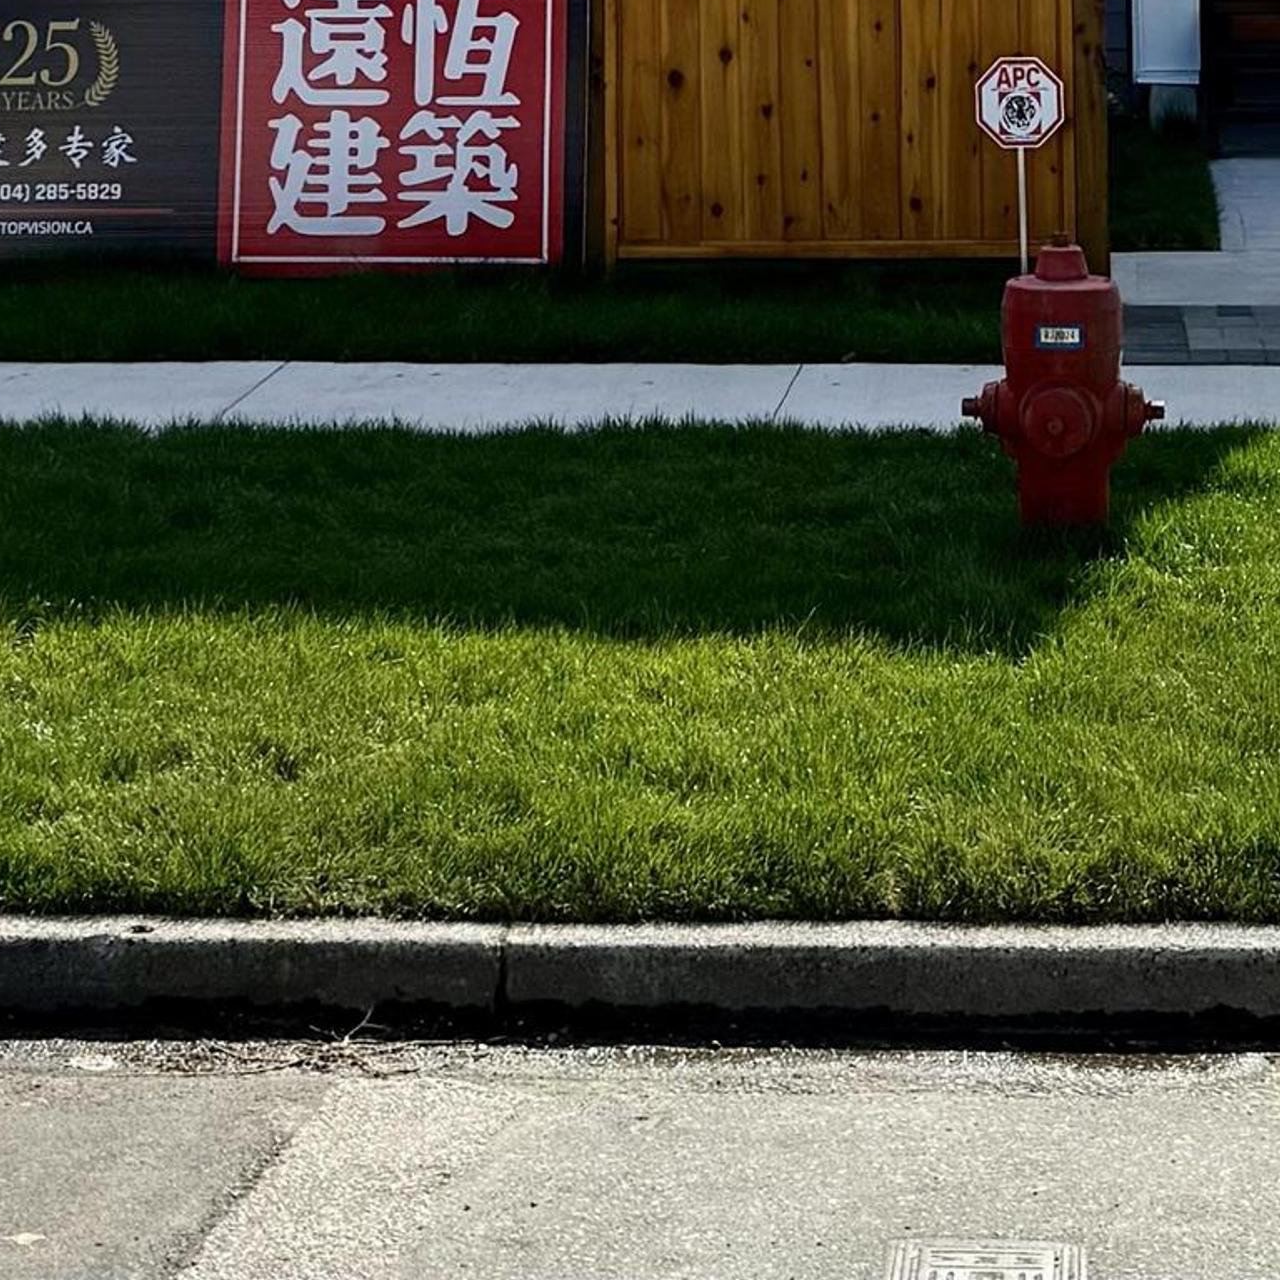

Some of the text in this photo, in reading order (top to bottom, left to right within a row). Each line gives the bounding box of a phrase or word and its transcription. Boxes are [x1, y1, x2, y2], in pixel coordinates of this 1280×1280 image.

[0, 17, 80, 87] 25
[996, 66, 1040, 88] APC
[0, 91, 74, 111] YEARS
[35, 183, 122, 201] 285-5829
